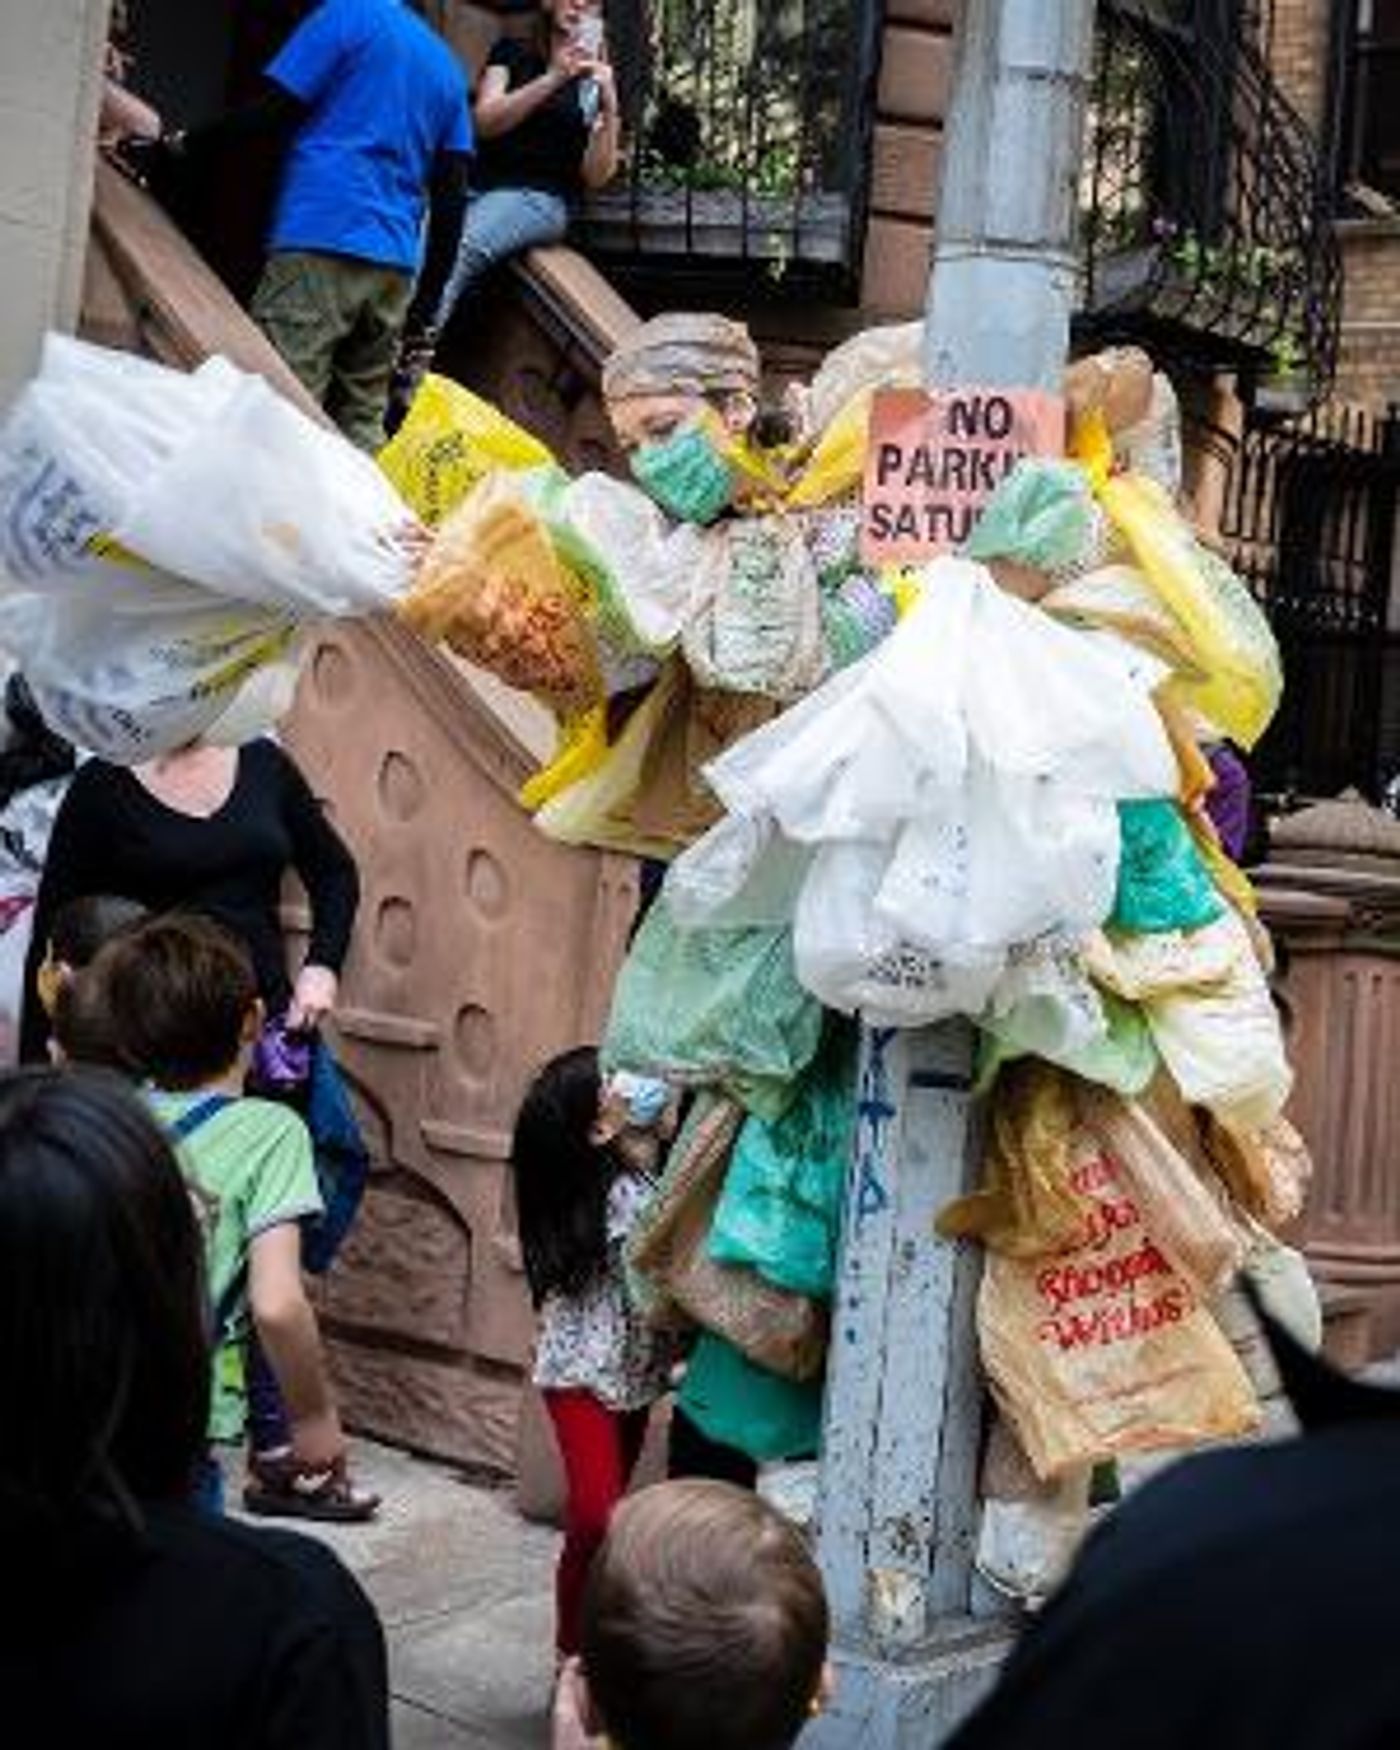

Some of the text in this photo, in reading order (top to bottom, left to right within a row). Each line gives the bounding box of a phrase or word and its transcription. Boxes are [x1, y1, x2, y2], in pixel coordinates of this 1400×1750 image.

[948, 396, 1013, 439] NO
[876, 442, 1024, 491] PARKI
[868, 503, 985, 544] SATU
